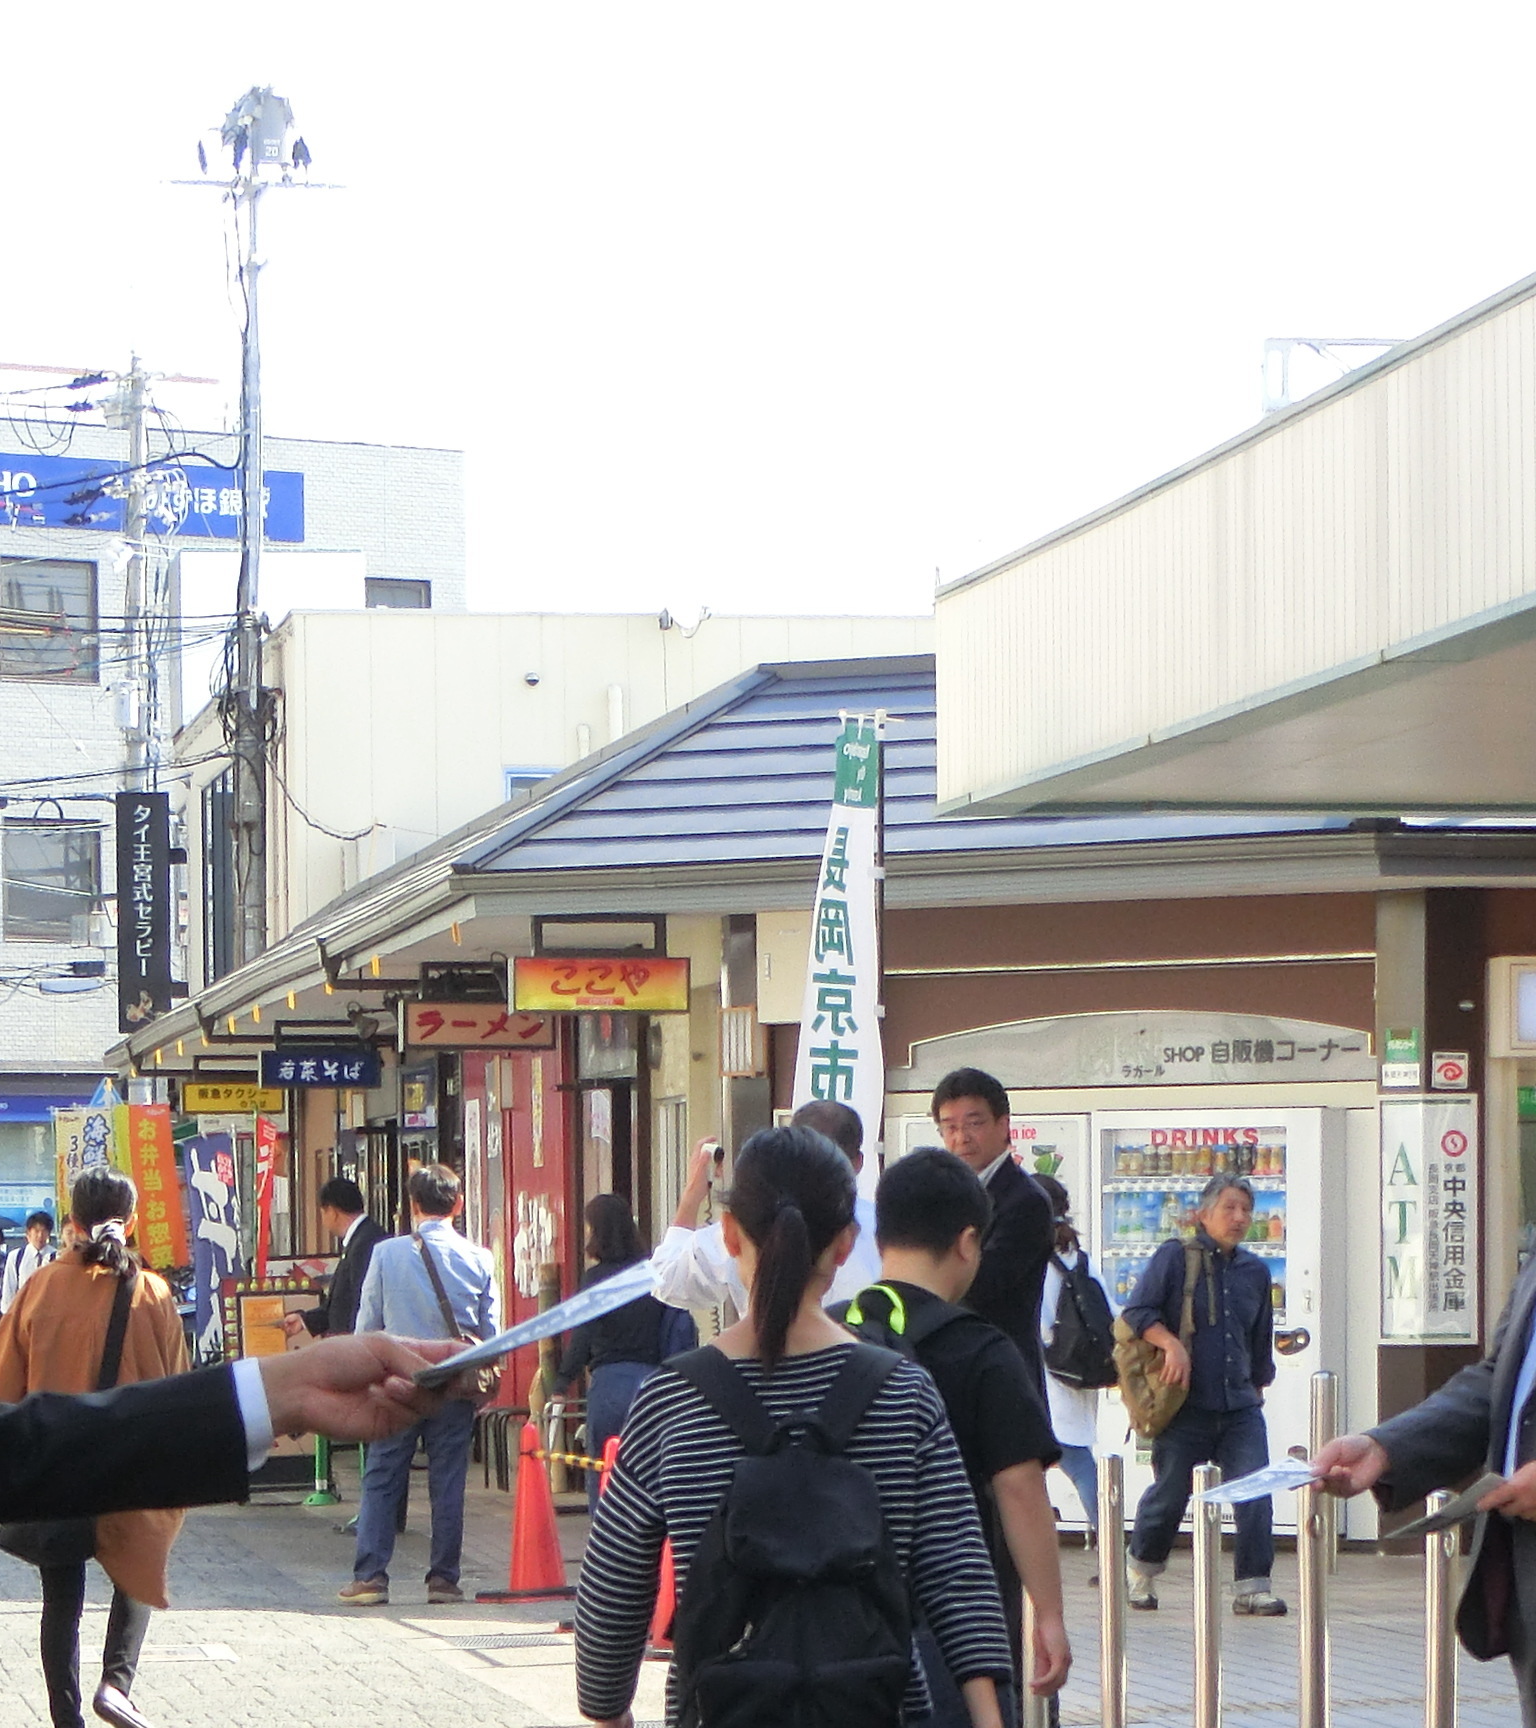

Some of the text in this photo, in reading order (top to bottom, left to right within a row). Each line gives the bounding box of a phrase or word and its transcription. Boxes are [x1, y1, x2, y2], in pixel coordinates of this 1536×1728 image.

[144, 485, 271, 520] みずほ銀
[132, 804, 155, 977] タイ王宮式セラピー
[551, 963, 650, 996] ここや
[416, 1010, 544, 1040] ラーメン
[1164, 1046, 1205, 1064] SHOP
[1211, 1037, 1361, 1065] 自販機コーナー
[277, 1058, 365, 1082] 若菜そば
[1121, 1064, 1166, 1079] ラガール
[198, 1087, 270, 1100] 阪急タクシー
[1151, 1127, 1260, 1146] DRINKS
[1443, 1162, 1466, 1173] 京都
[1386, 1141, 1419, 1300] ATM
[1442, 1175, 1467, 1312] 中央信用金庫
